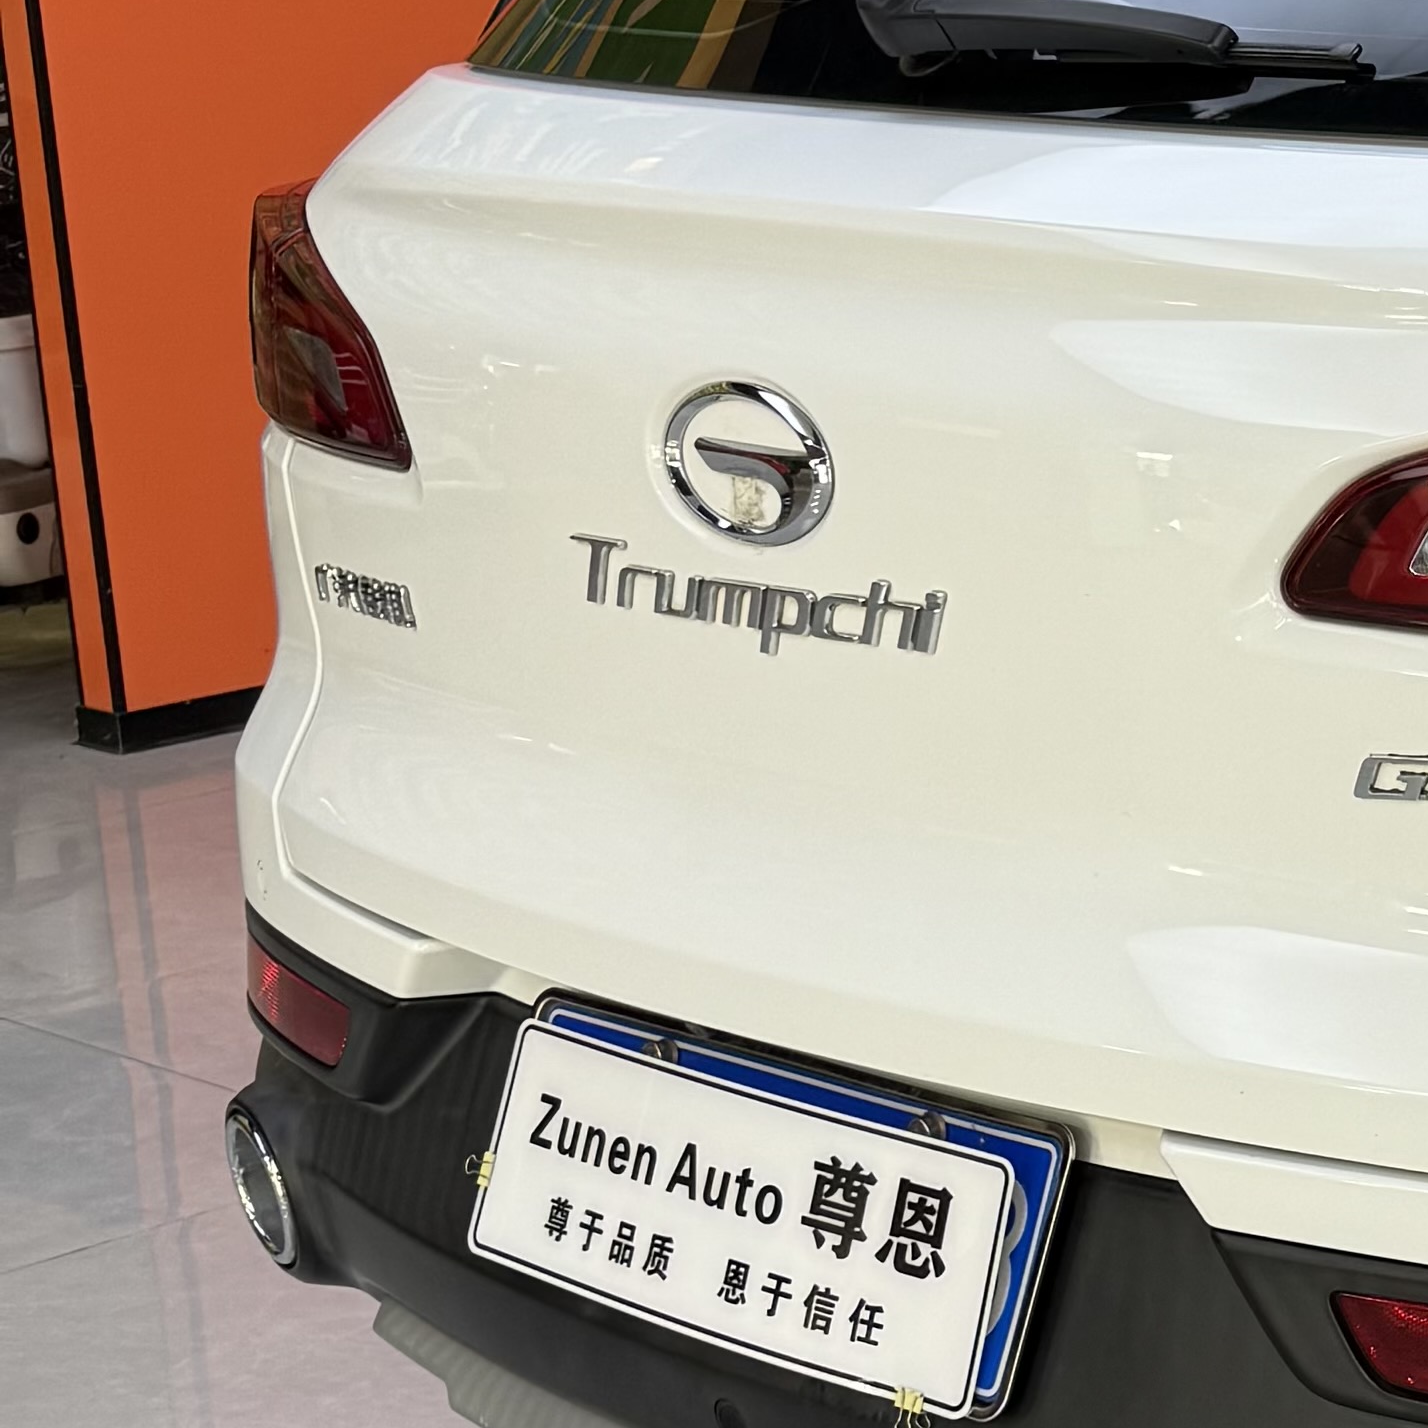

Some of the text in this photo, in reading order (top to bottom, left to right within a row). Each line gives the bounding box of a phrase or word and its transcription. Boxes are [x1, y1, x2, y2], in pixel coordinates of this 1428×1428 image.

[569, 532, 948, 656] Trumpchi
[529, 1093, 659, 1186] Zunen
[665, 1143, 785, 1225] Auto
[800, 1154, 956, 1280] 尊恩
[543, 1196, 886, 1347] 尊于品质 恩于信任
